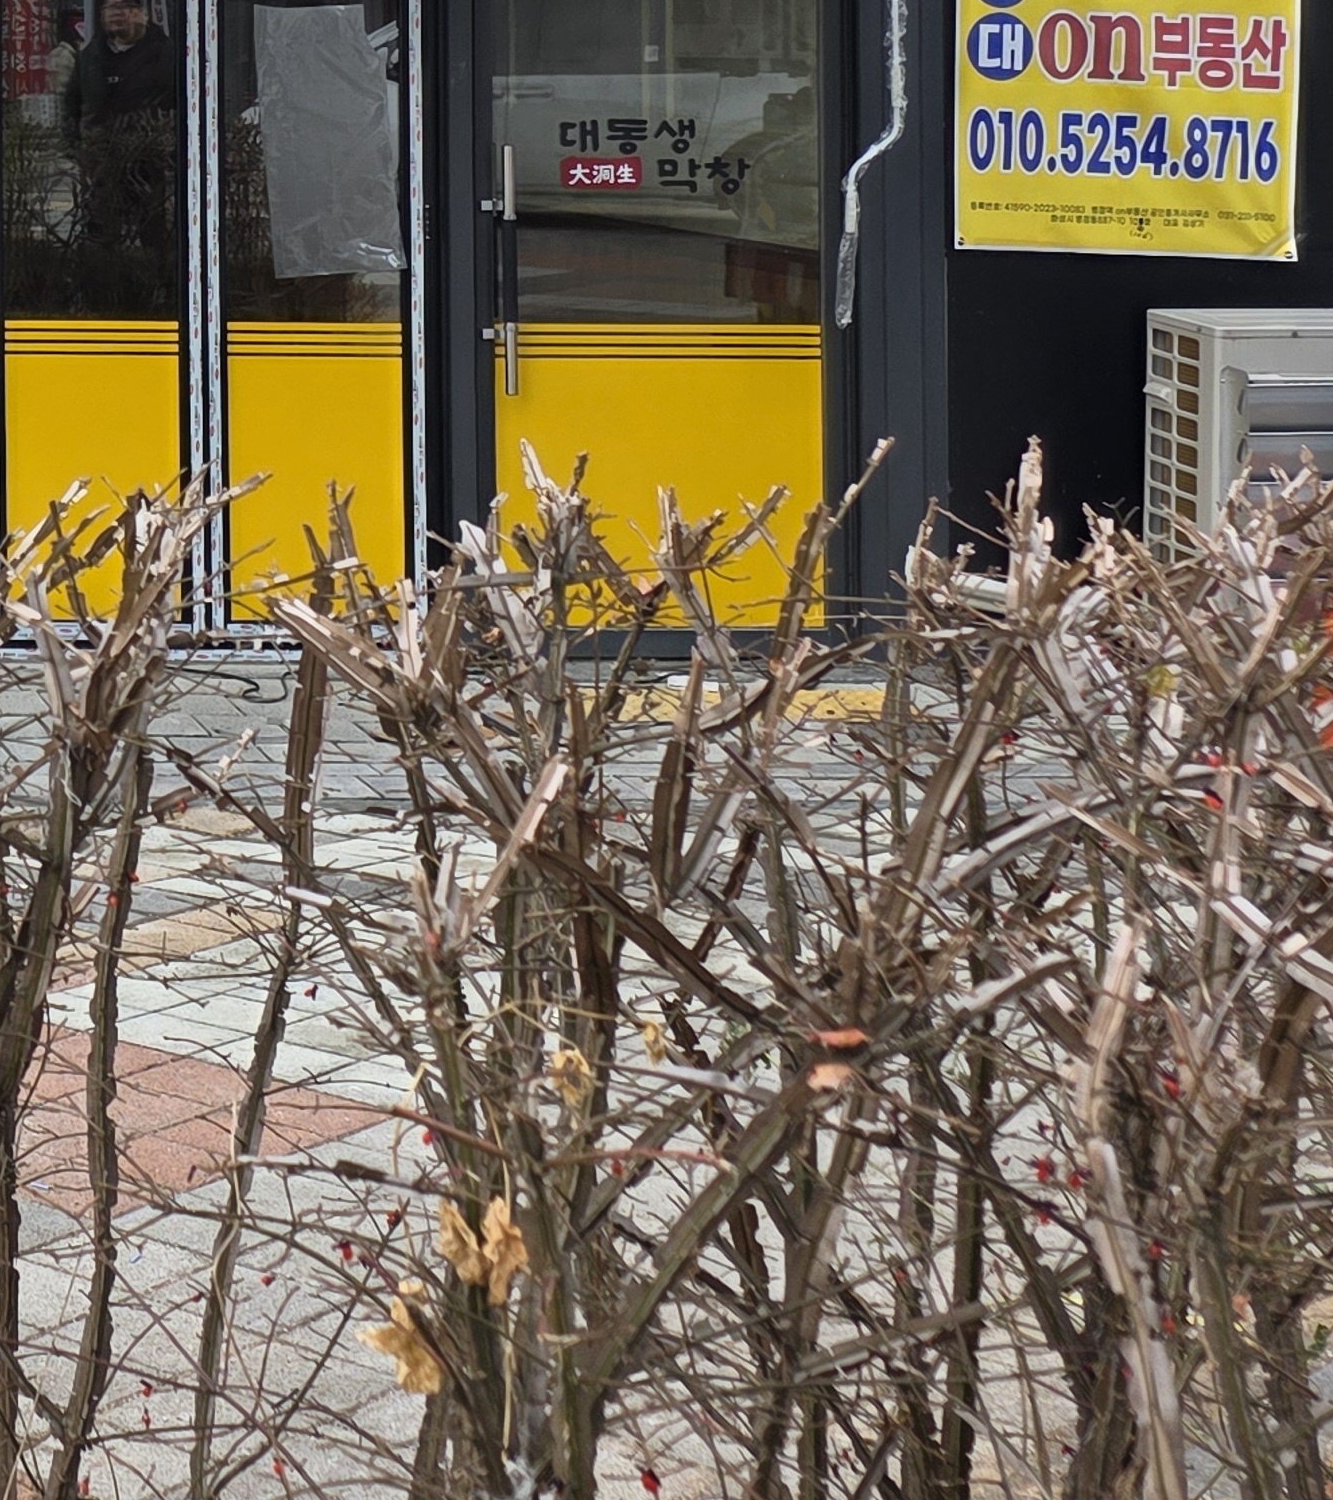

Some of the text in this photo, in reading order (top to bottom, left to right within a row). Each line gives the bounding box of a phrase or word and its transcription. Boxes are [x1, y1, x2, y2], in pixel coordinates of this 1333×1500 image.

[559, 118, 696, 155] 대동생
[969, 108, 1279, 182] 010.5254.8716
[568, 163, 637, 186] 大洞生
[656, 156, 751, 195] 막창
